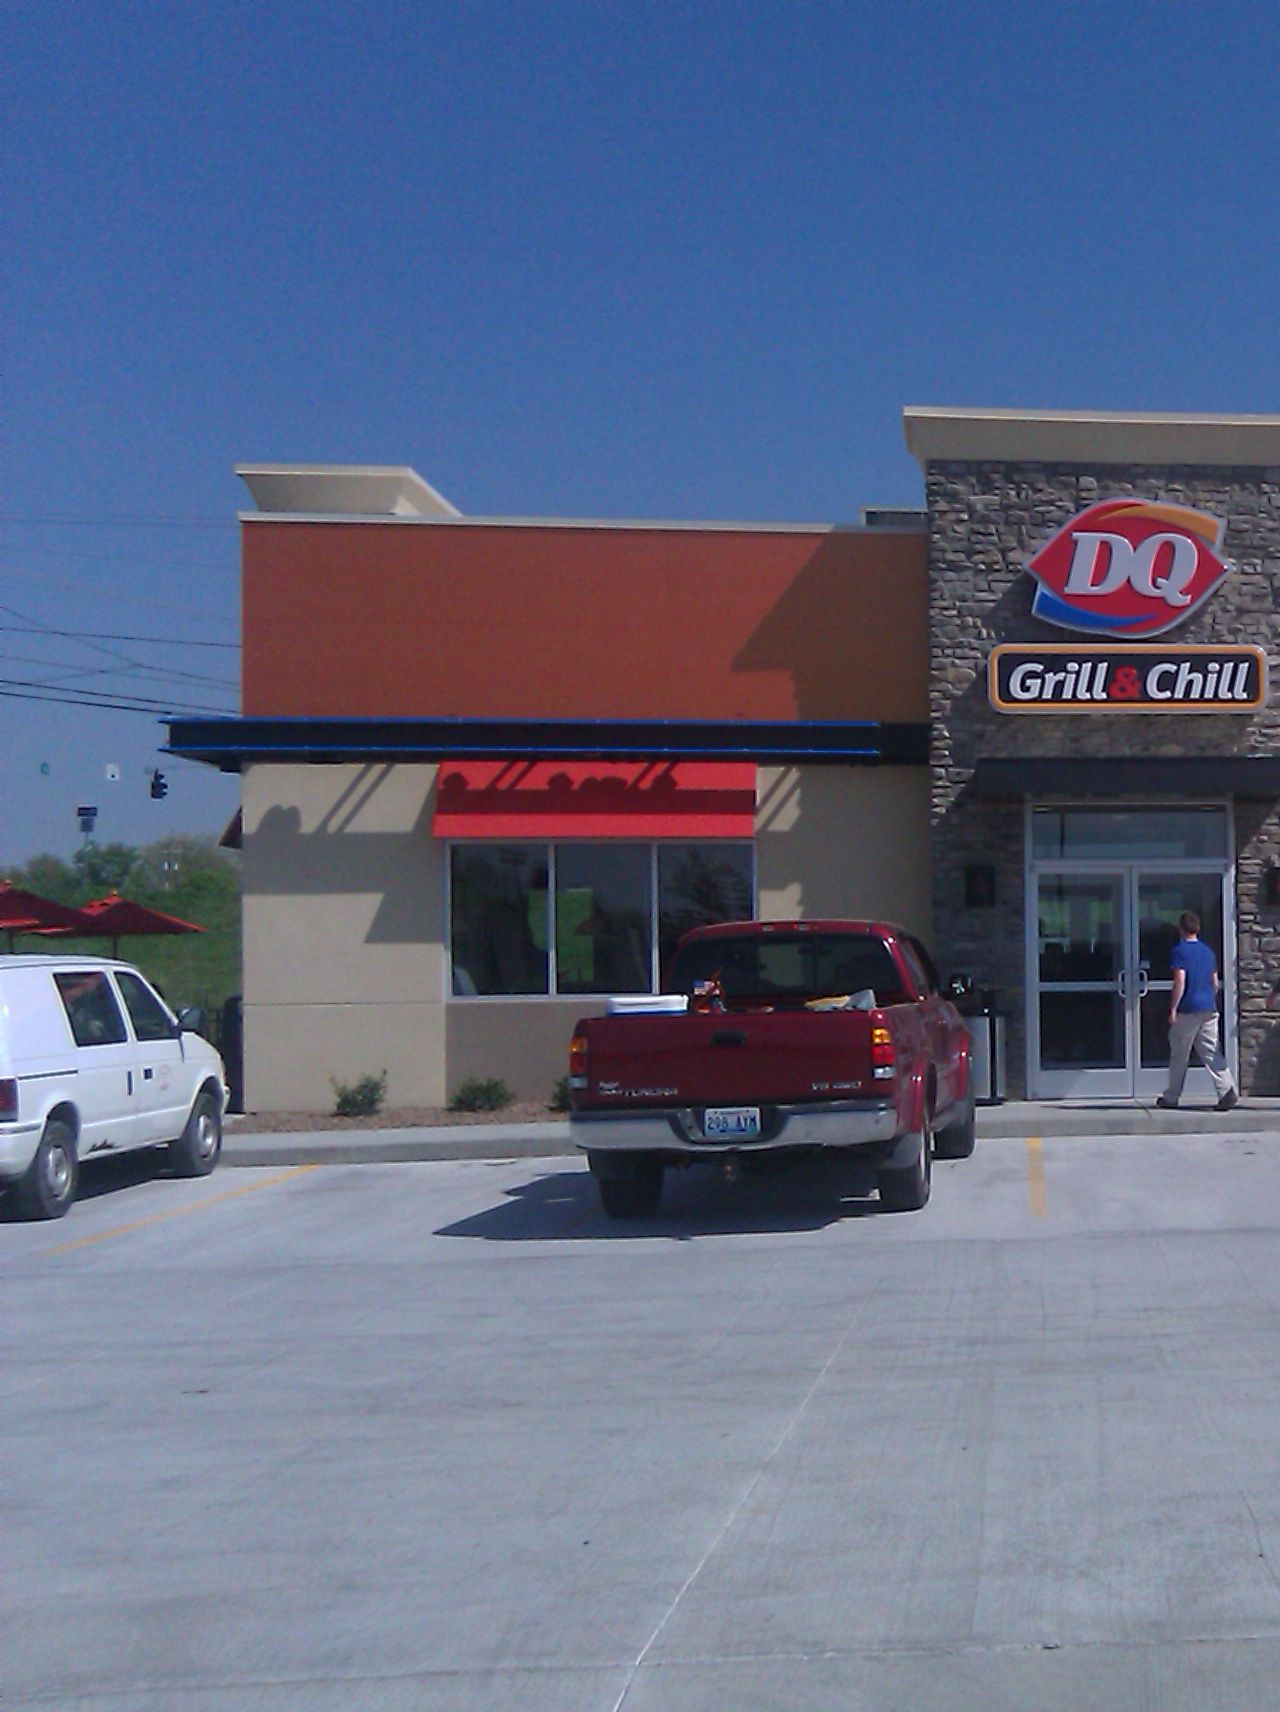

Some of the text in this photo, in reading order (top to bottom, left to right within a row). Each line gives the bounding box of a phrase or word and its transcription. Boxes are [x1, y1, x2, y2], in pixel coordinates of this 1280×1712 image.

[1063, 532, 1199, 607] DQ
[1009, 662, 1108, 700] Grill
[1146, 662, 1249, 700] Chill
